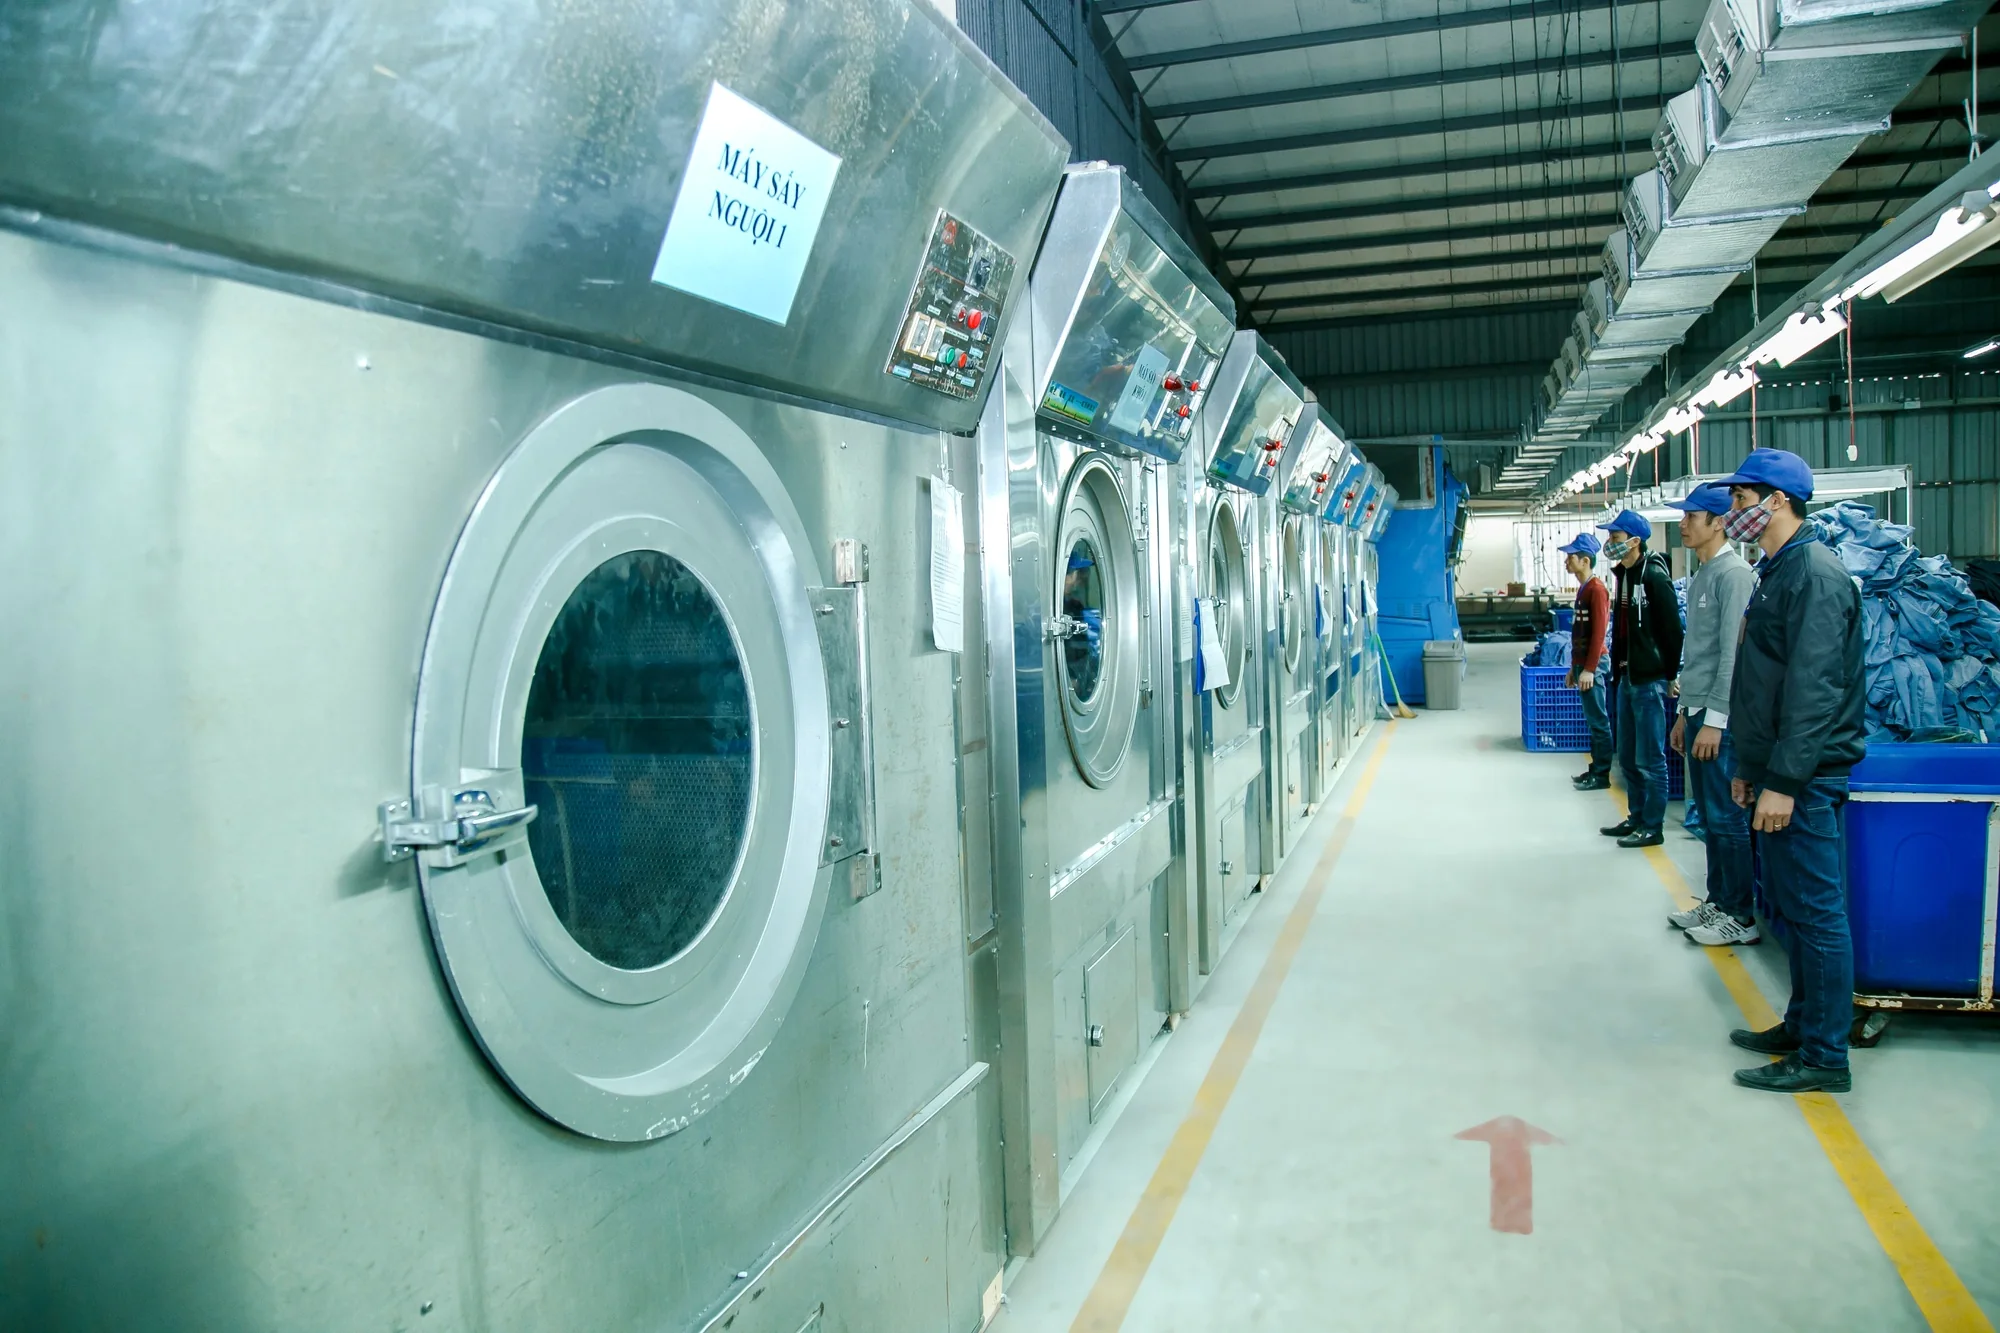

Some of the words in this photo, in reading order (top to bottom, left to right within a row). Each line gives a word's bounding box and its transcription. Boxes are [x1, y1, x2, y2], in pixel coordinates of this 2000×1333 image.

[717, 142, 768, 190] MÁY
[767, 170, 806, 210] SẤY
[708, 190, 776, 245] NGUỘI
[776, 224, 787, 249] 1
